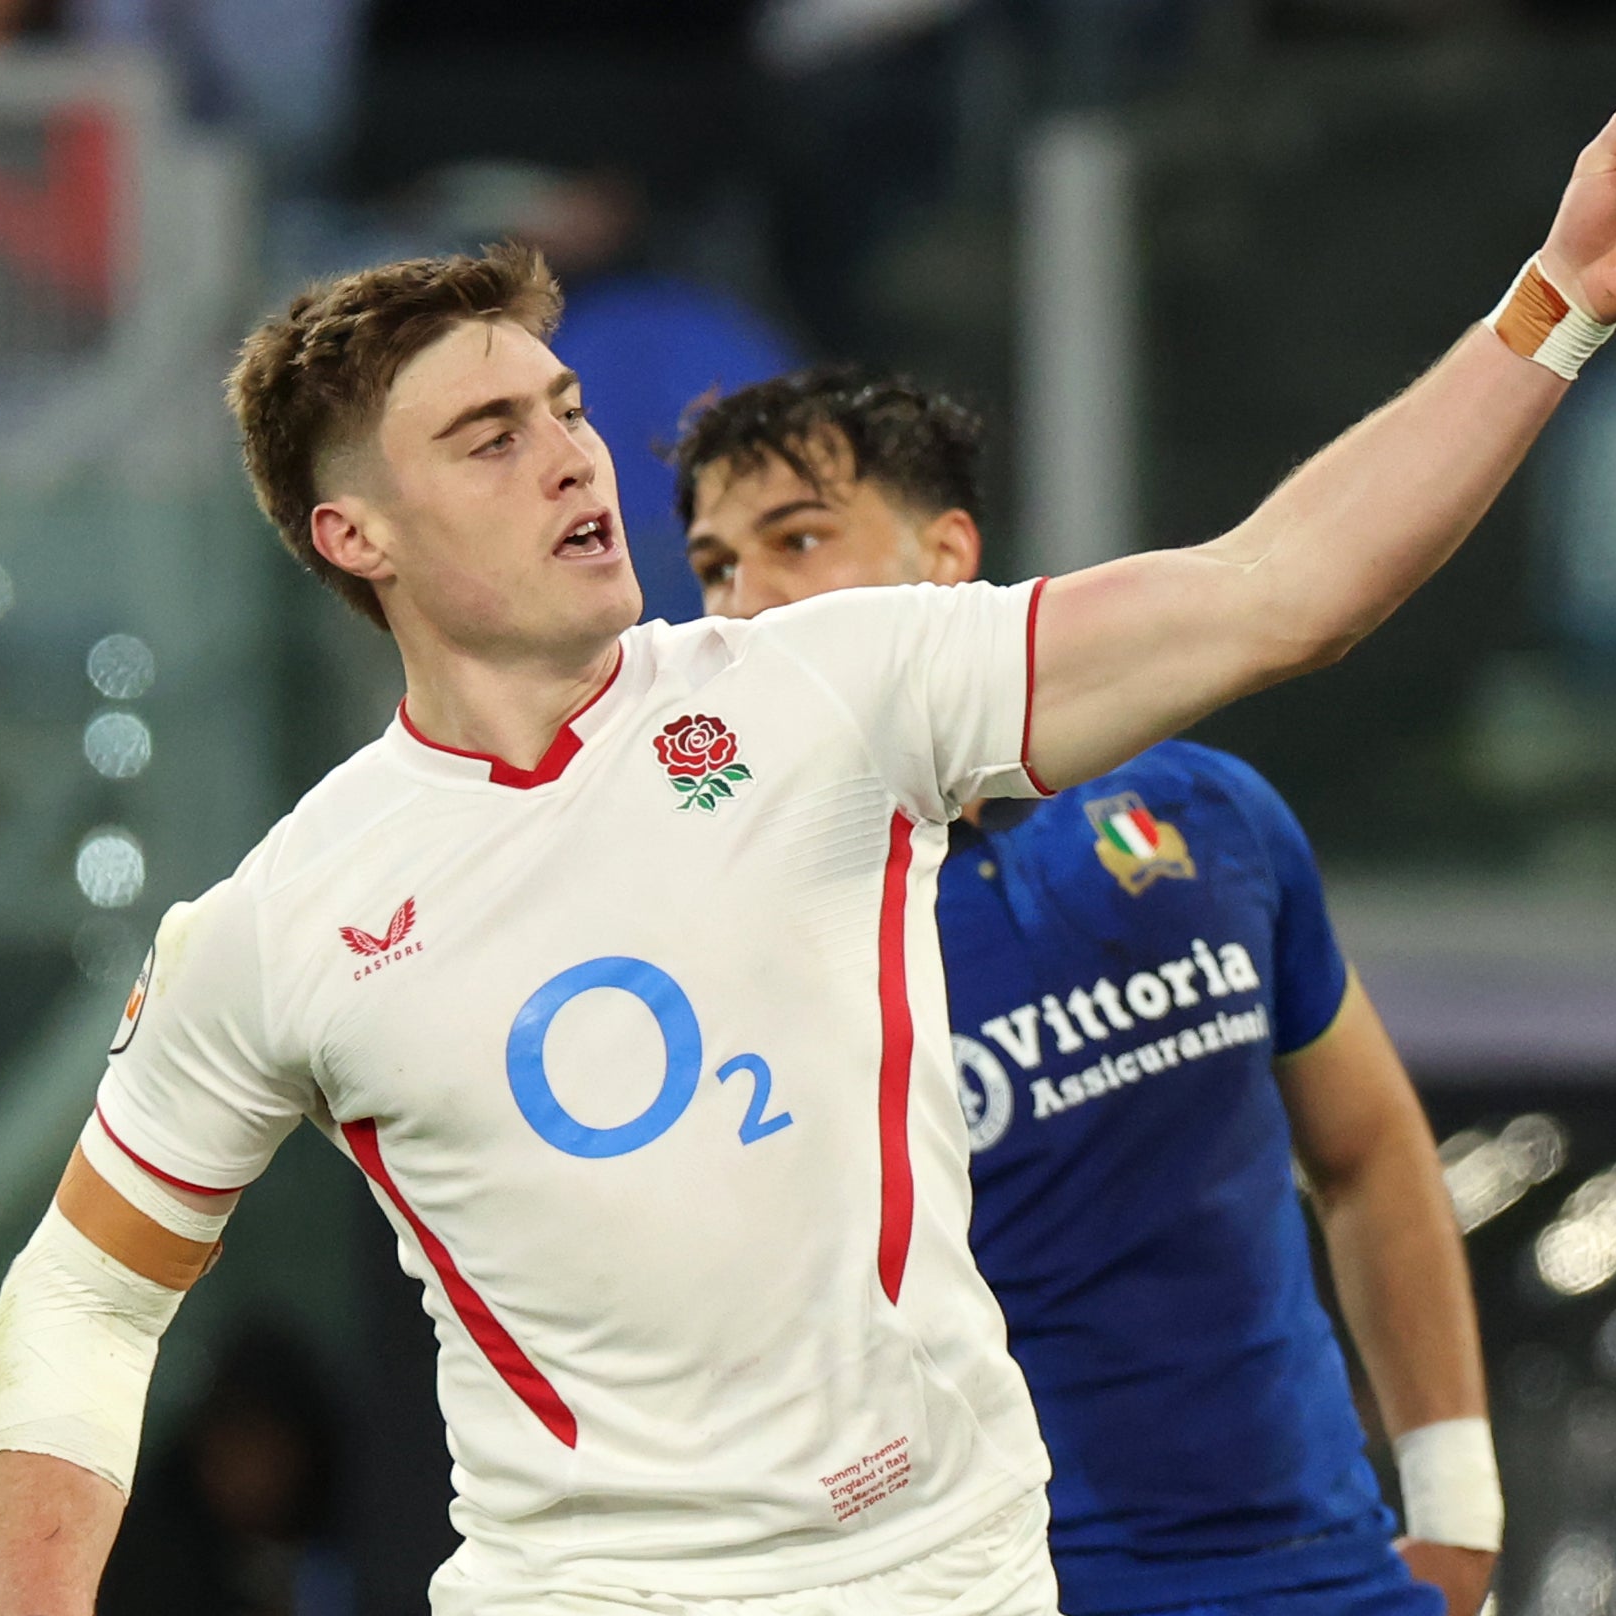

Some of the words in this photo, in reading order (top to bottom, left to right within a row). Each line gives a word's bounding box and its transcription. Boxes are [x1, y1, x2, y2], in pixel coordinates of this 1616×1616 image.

[353, 941, 423, 981] CASTORE
[980, 937, 1261, 1070] Vittoria
[1030, 1002, 1270, 1120] Assicurazioni
[820, 1463, 860, 1487] Tommy
[863, 1436, 908, 1466] Freeman
[831, 1470, 876, 1499] England
[886, 1451, 908, 1469] Italy
